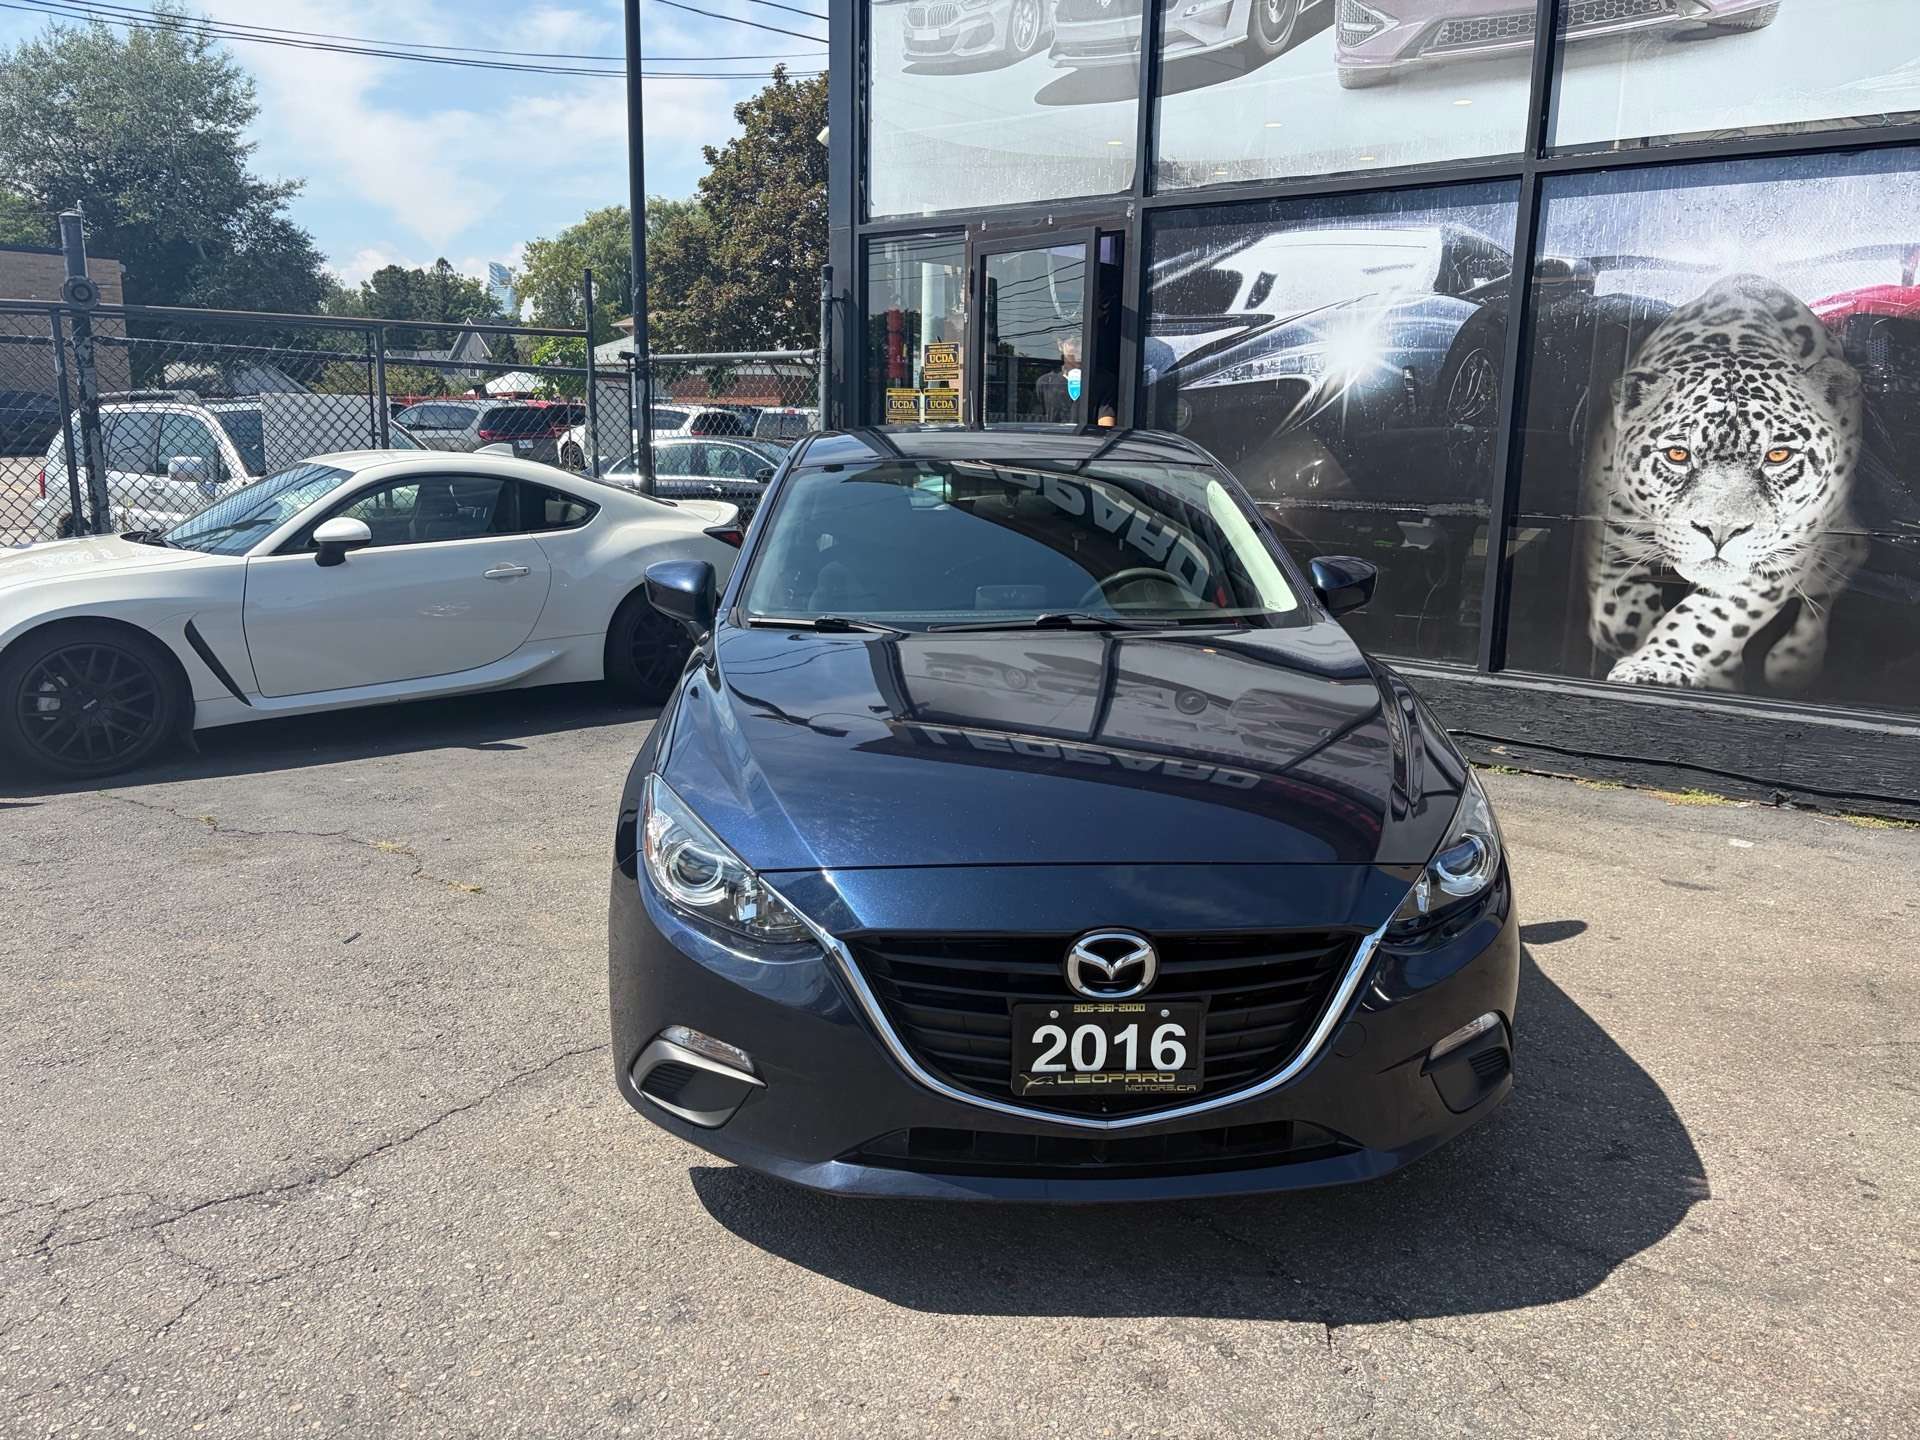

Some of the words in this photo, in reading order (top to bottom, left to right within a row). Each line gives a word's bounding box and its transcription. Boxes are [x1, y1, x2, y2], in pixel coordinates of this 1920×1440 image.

[929, 353, 955, 363] UCDA
[892, 400, 915, 409] UCDA
[930, 400, 954, 409] UCDA
[1073, 1004, 1145, 1013] 905-361-2000
[1031, 1023, 1187, 1072] 2016
[1057, 1073, 1175, 1084] LEOPARD
[1125, 1084, 1196, 1092] MOTORS.CA
